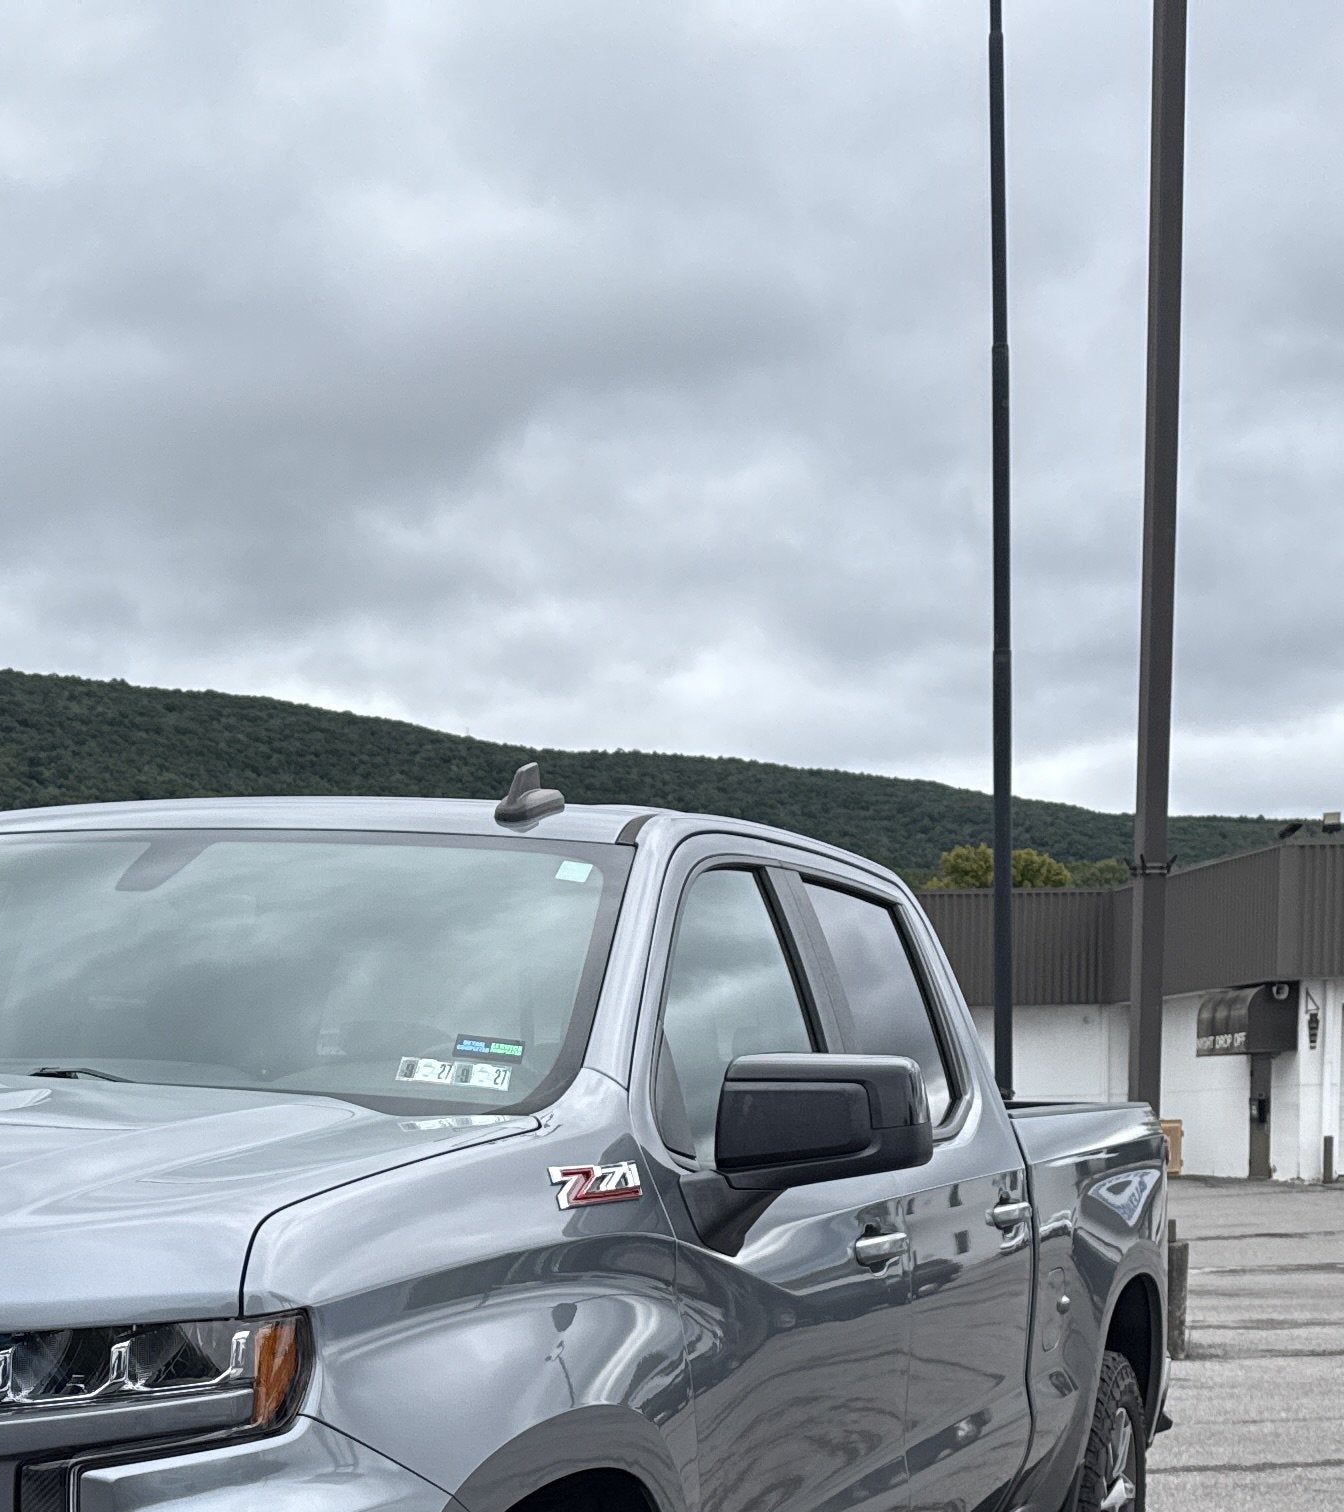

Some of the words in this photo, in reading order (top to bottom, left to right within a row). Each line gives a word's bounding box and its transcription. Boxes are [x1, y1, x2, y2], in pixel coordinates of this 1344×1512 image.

[437, 1063, 452, 1080] 27
[493, 1069, 507, 1086] 27
[547, 1160, 643, 1211] Z71
